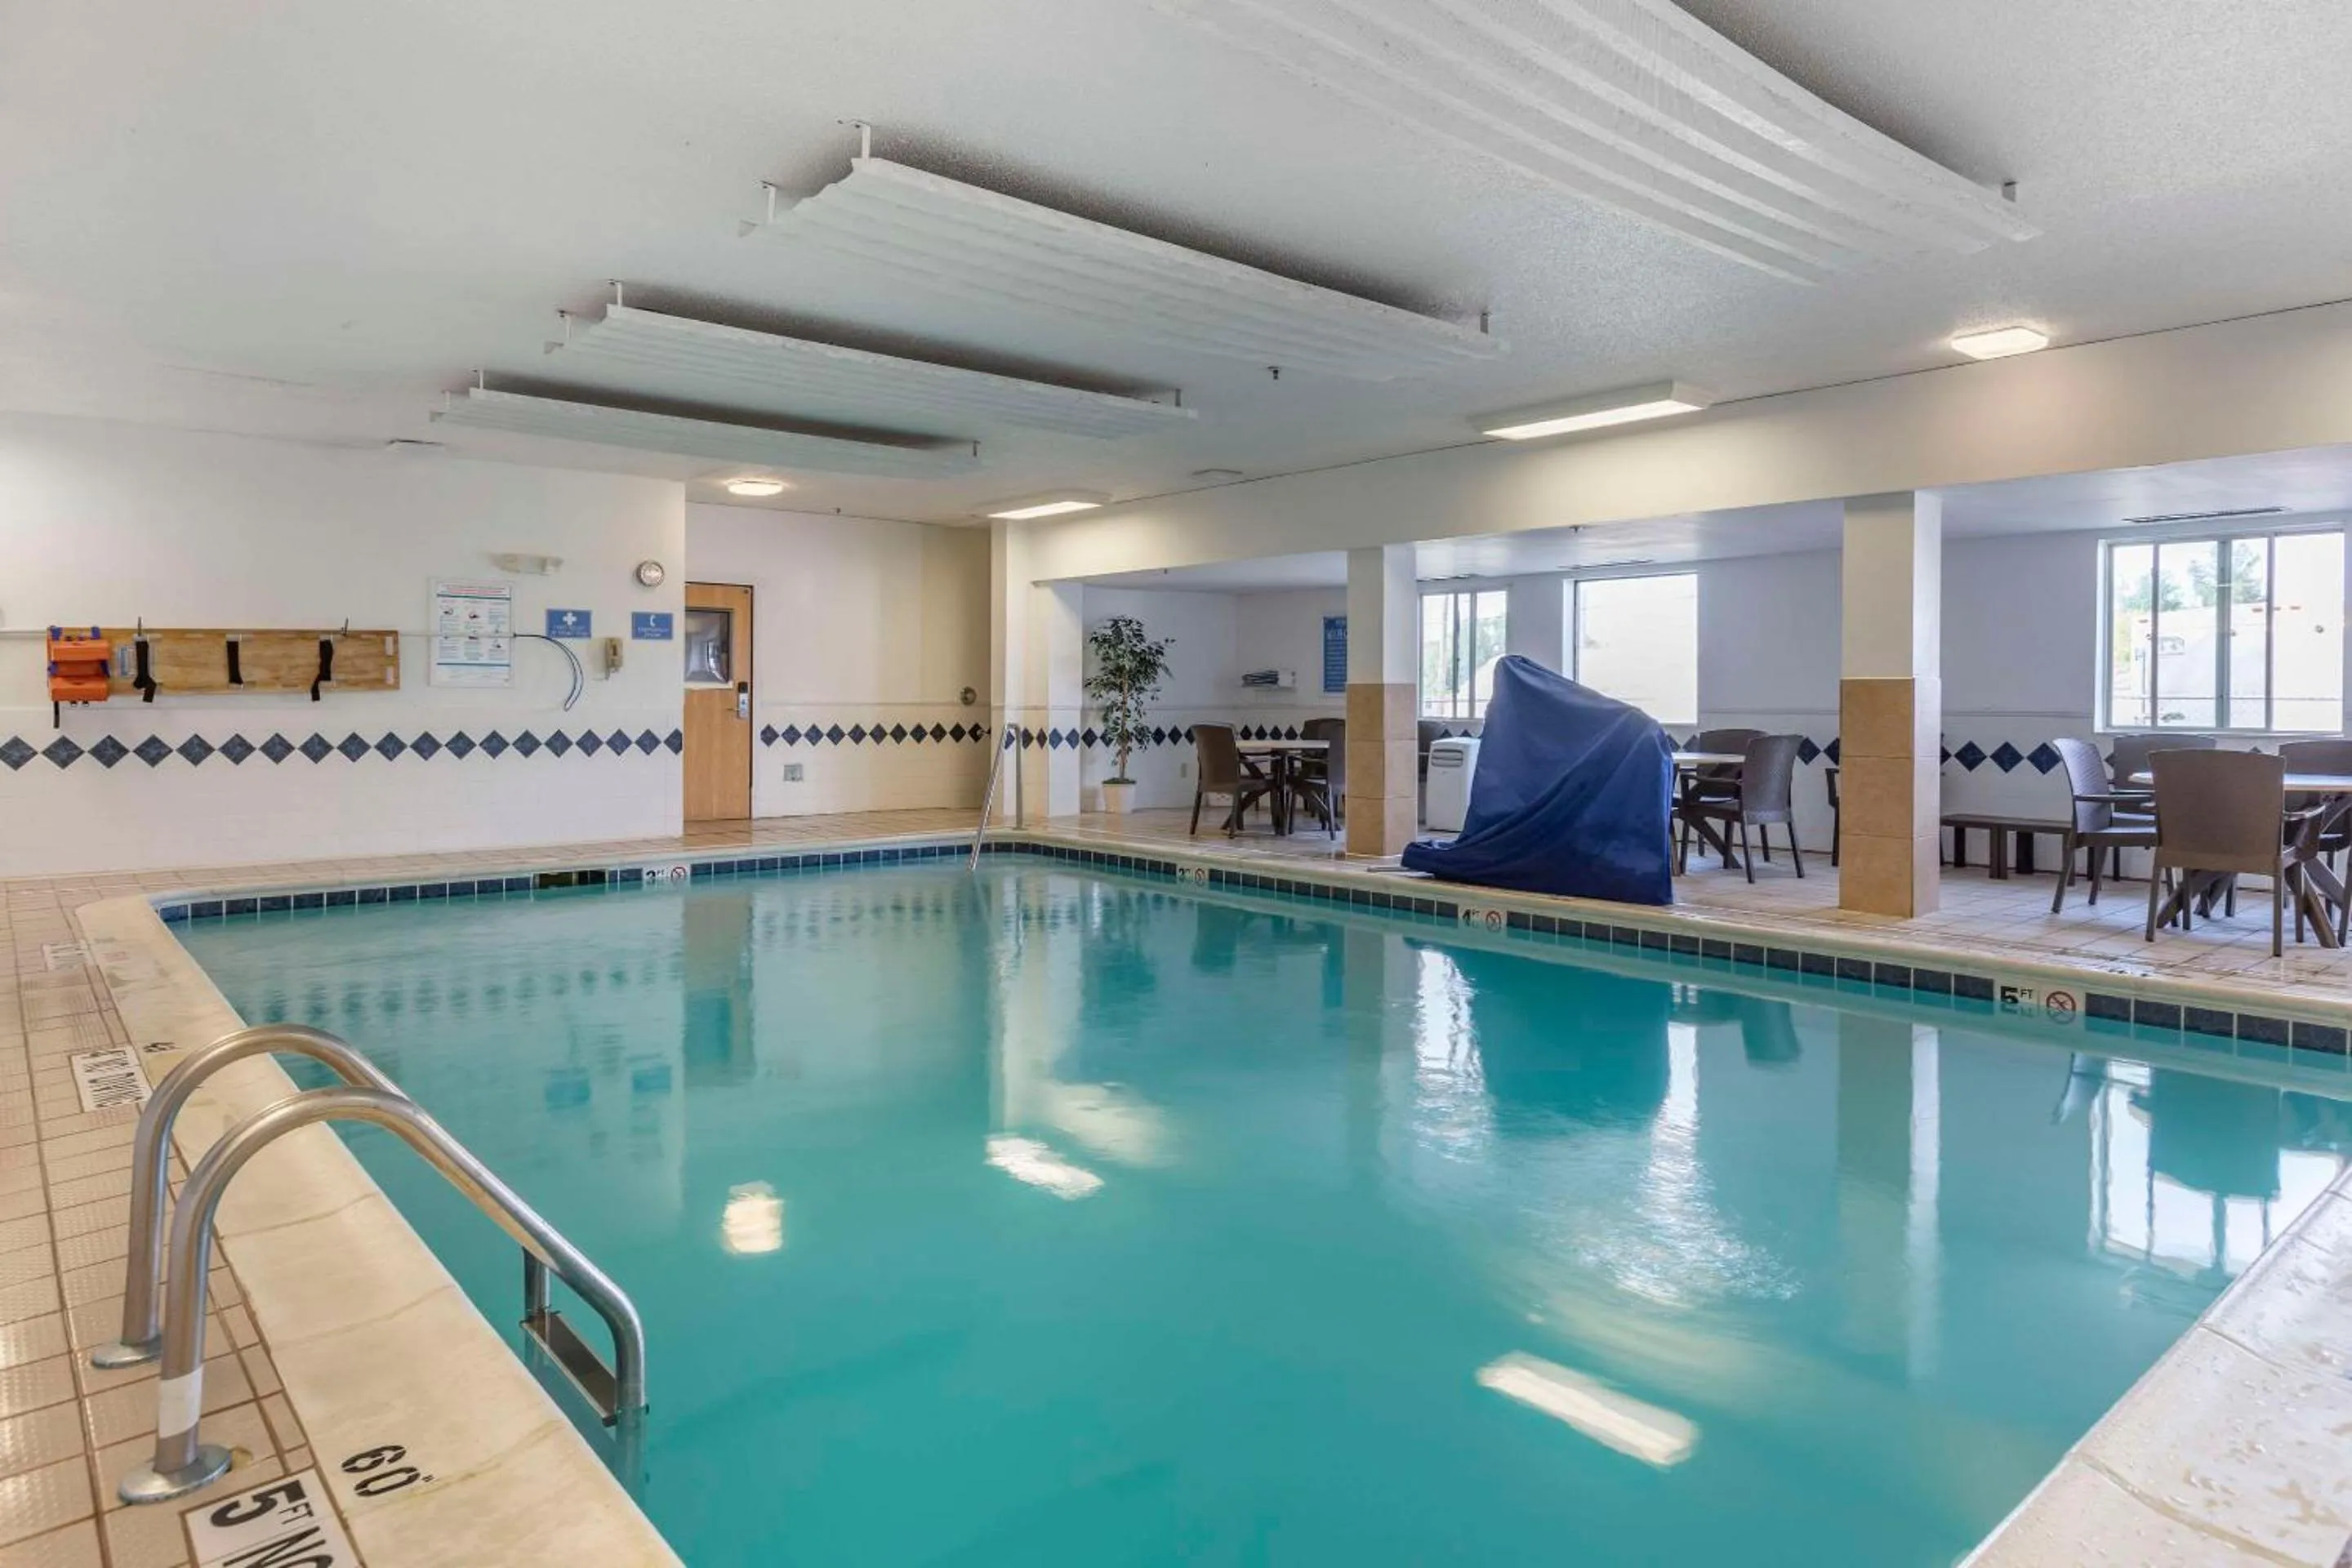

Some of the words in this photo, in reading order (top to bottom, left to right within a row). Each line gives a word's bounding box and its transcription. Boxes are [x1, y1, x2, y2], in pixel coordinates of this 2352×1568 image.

[2000, 986, 2019, 1004] 5
[2020, 988, 2034, 1000] FT
[210, 1479, 307, 1528] 5
[276, 1501, 315, 1526] FT
[222, 1525, 334, 1568] N
